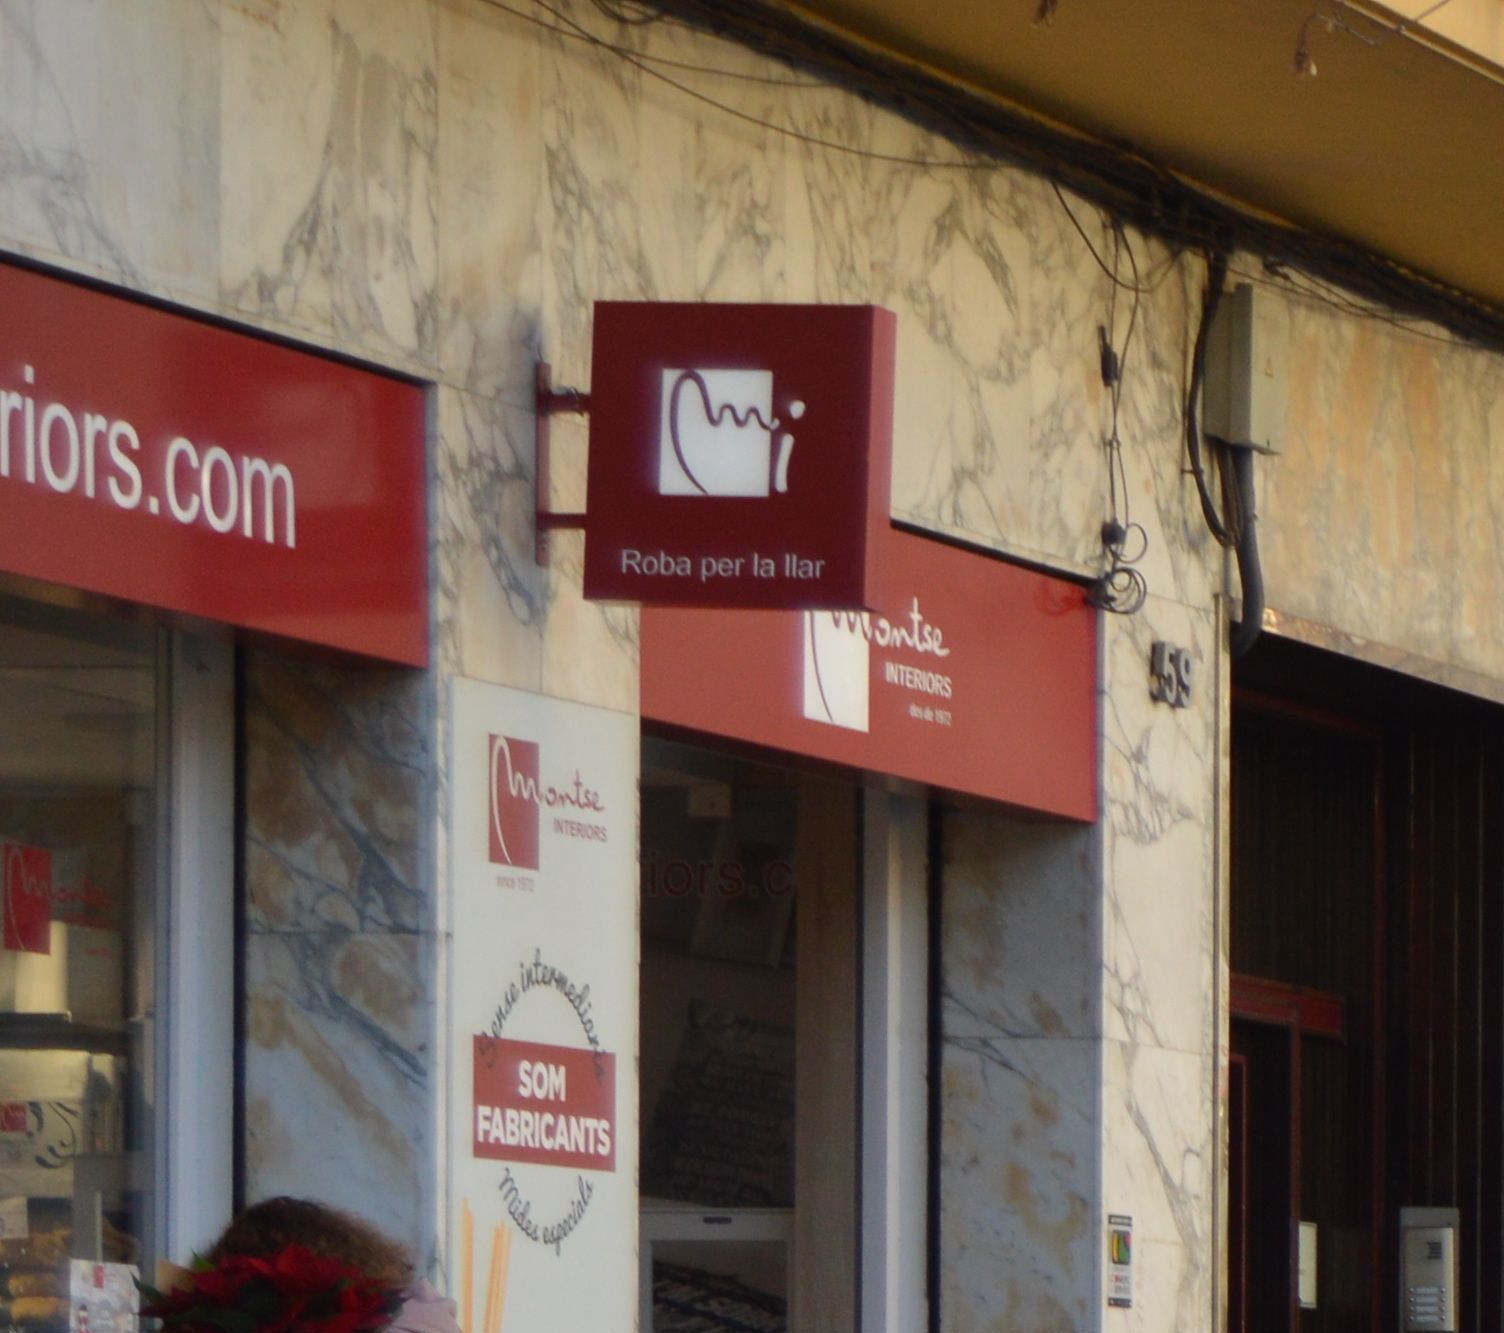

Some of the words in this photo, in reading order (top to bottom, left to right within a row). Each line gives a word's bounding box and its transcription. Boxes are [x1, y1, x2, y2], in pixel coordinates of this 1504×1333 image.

[620, 549, 691, 576] Roba
[700, 555, 744, 583] per
[752, 553, 775, 578] la
[784, 554, 825, 579] llar
[885, 661, 952, 699] INTERIORS
[553, 818, 608, 843] INTERIORS
[517, 1060, 567, 1102] SOM
[476, 1104, 611, 1157] FABRICANTS
